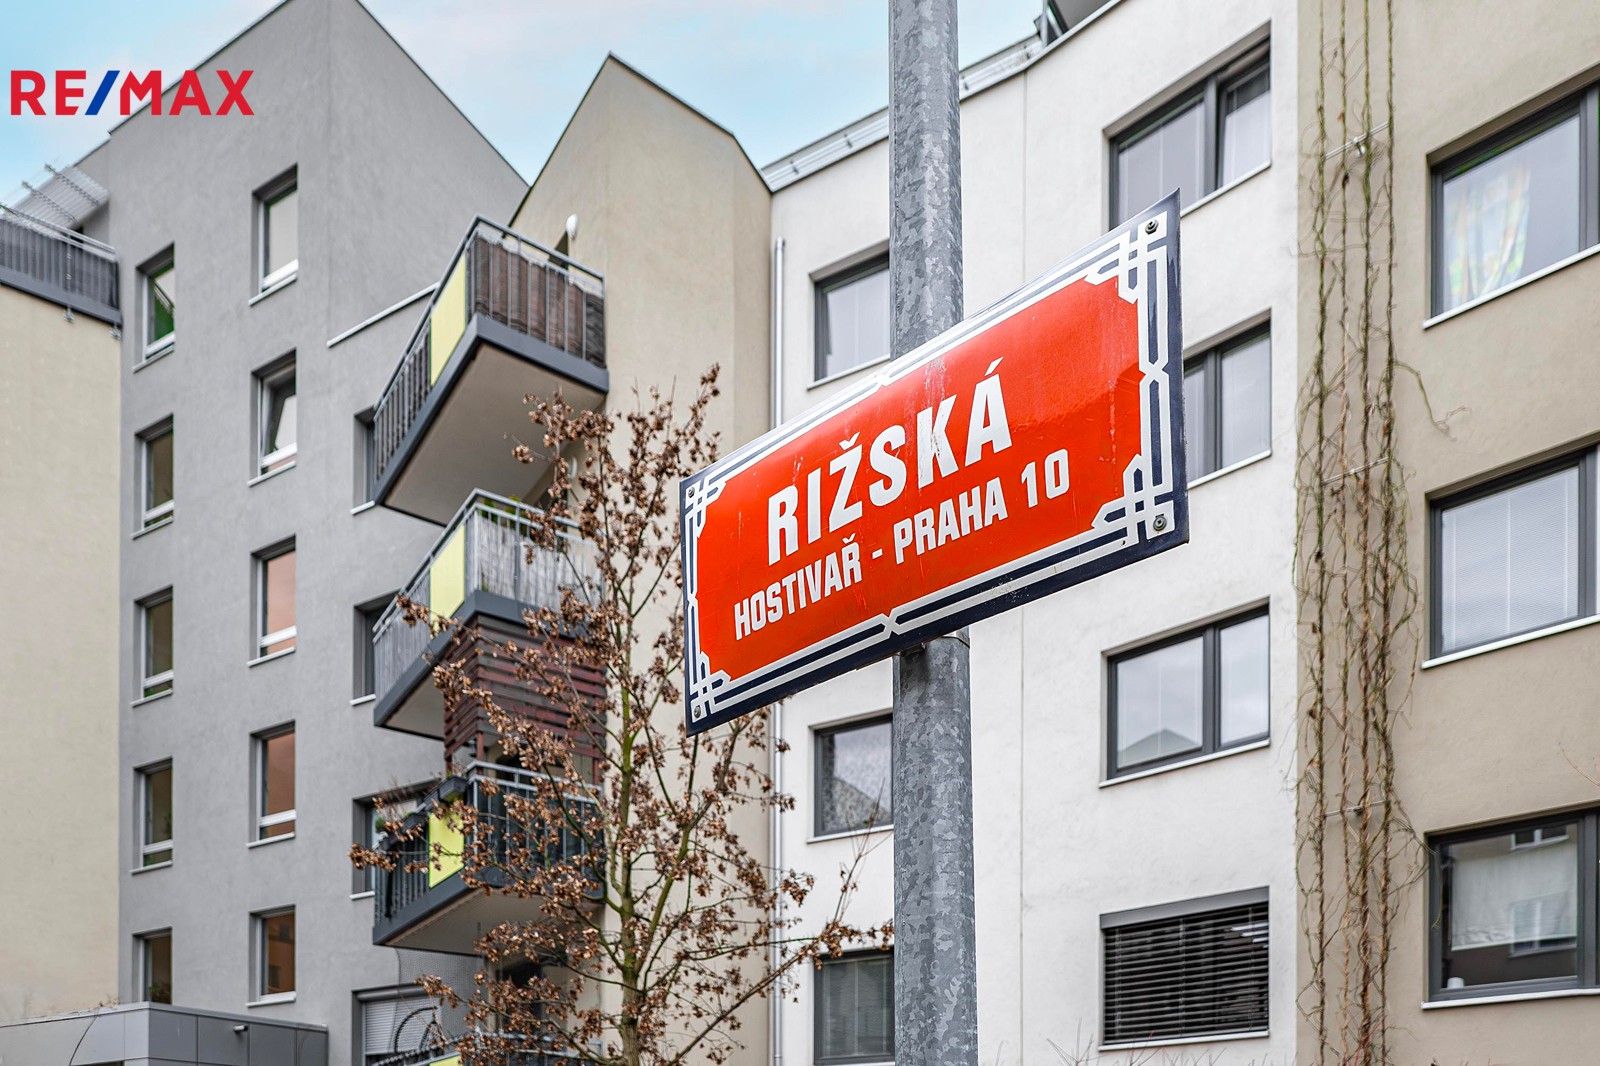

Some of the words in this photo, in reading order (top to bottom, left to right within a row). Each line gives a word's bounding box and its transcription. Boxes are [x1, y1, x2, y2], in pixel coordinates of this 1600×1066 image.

[734, 533, 863, 641] HOSTIVAŘ
[893, 476, 1009, 566] PRAHA
[1021, 448, 1070, 508] 10
[768, 356, 1013, 567] RIŽSKÁ
